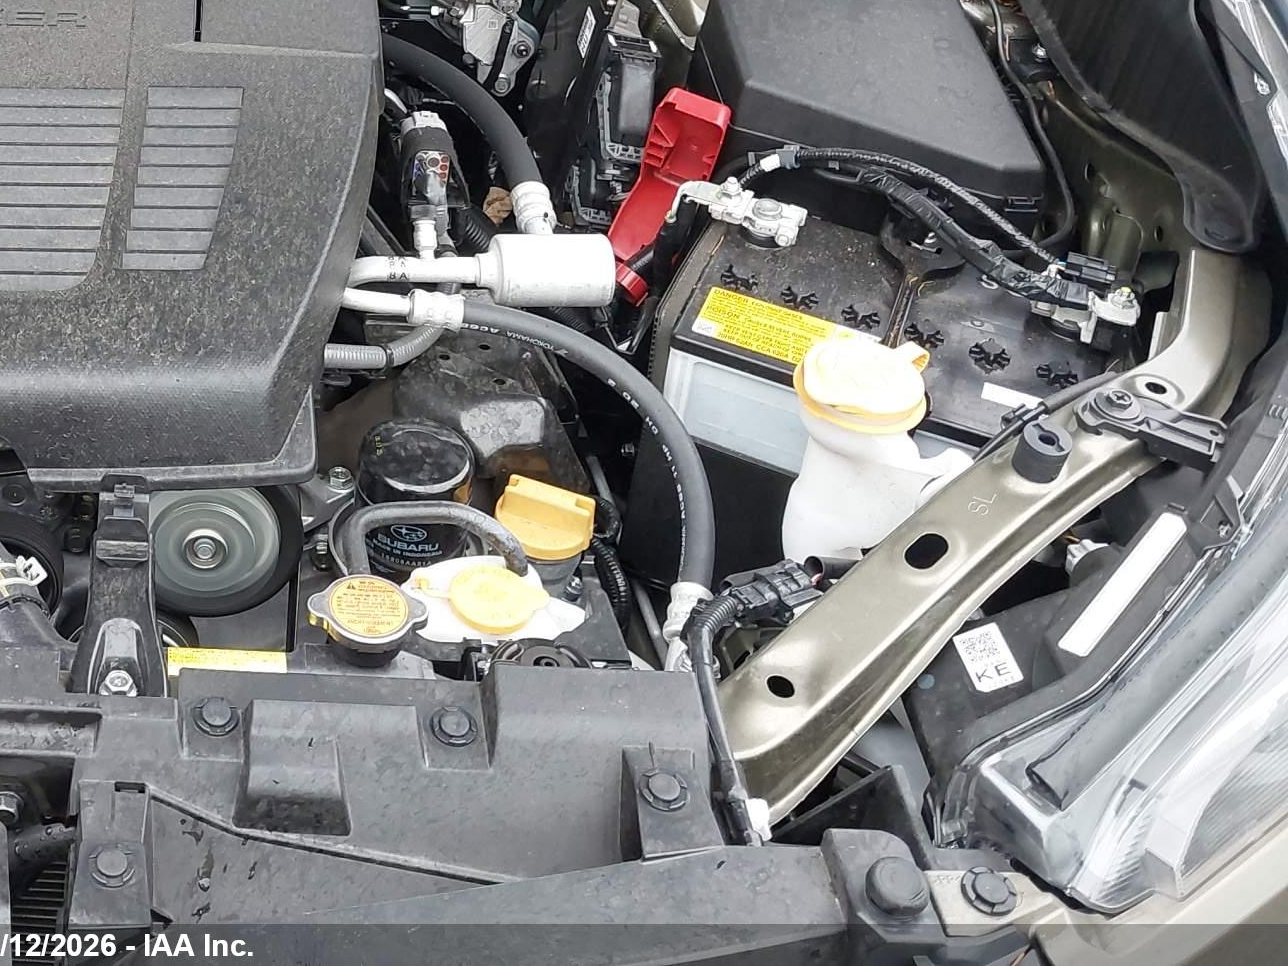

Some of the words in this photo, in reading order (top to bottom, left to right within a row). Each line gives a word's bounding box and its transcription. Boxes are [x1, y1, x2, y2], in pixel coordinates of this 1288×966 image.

[505, 331, 555, 352] YOKOHAMA
[968, 493, 998, 516] SL
[377, 533, 439, 553] SUBARU
[975, 662, 1012, 683] KE
